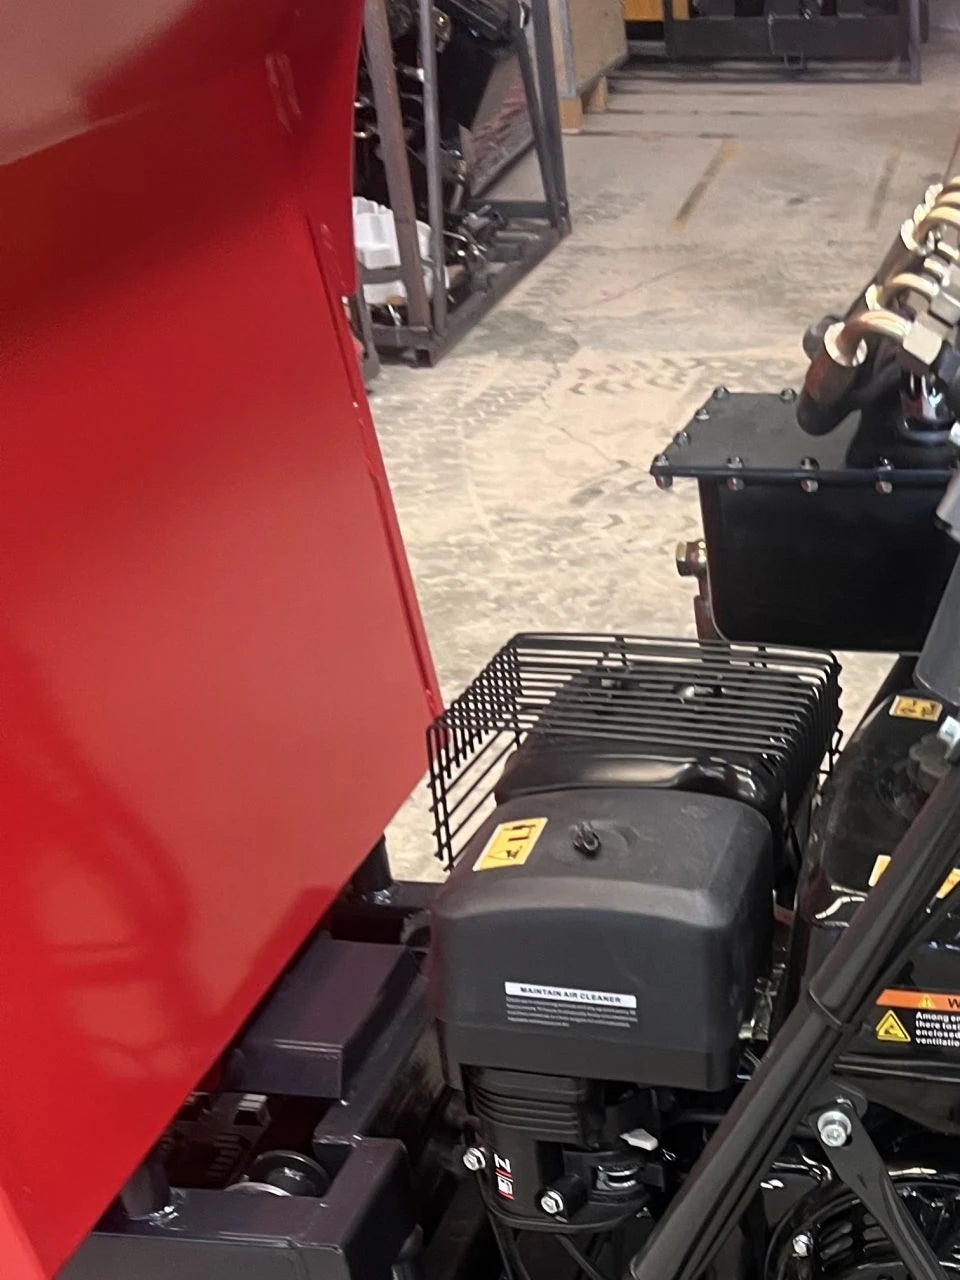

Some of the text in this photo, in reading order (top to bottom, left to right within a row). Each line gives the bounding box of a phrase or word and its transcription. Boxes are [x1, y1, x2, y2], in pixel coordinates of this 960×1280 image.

[520, 986, 622, 1004] MAINTAIN AIR CLEANER
[915, 1011, 949, 1023] Among
[915, 1020, 940, 1030] there
[915, 1029, 960, 1039] enclosed
